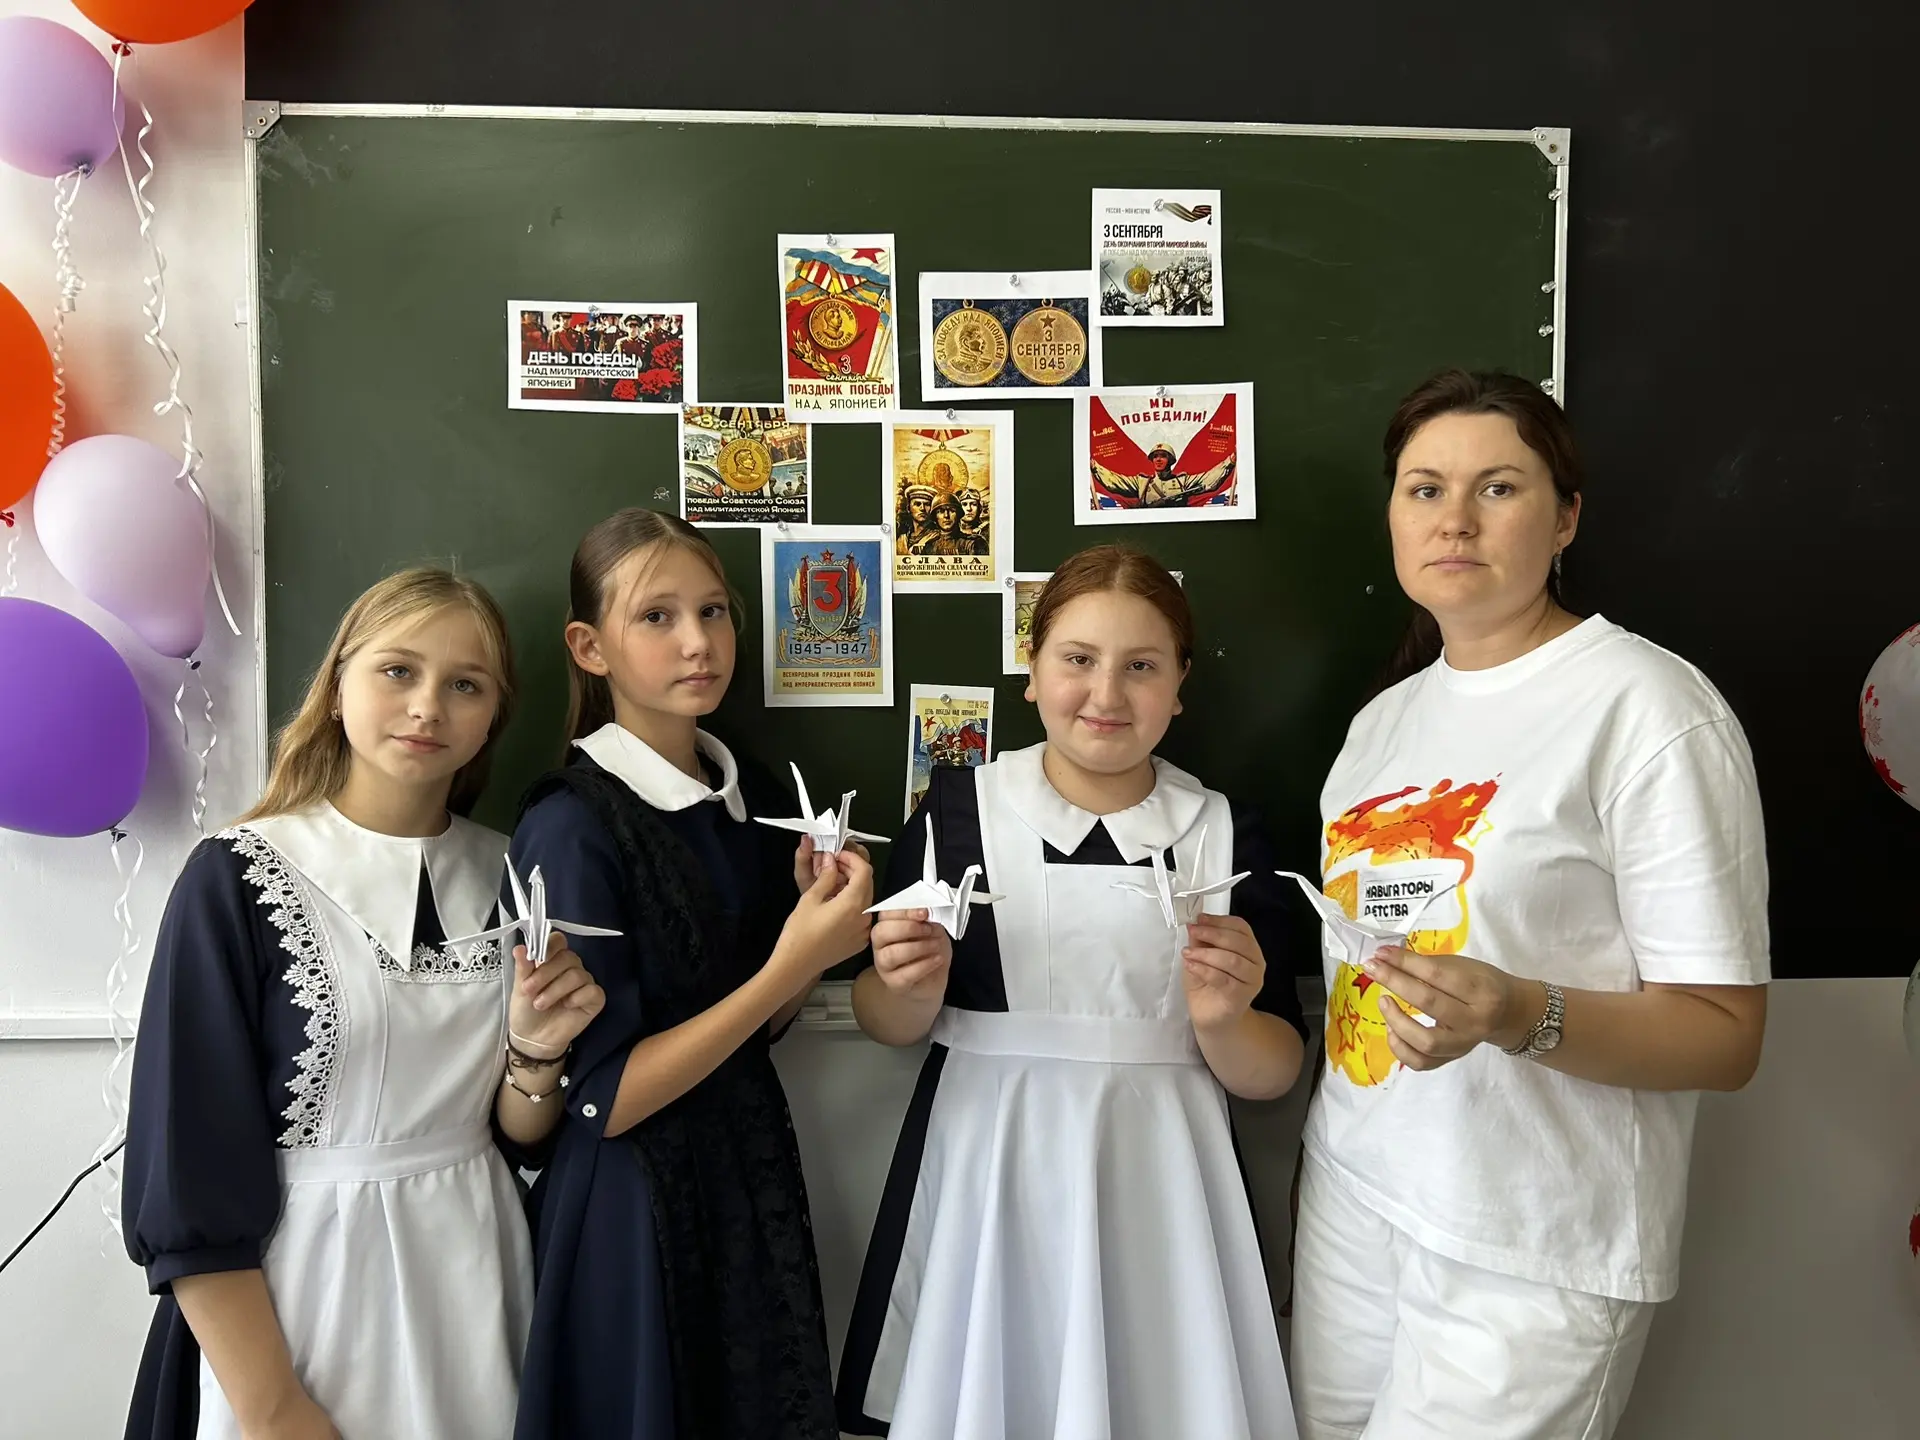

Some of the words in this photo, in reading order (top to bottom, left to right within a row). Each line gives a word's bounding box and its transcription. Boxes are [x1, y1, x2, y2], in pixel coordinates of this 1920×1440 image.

[1103, 224, 1110, 238] 3
[1112, 224, 1163, 238] СЕНТЯБРЯ
[1147, 240, 1165, 248] ВТОРОЙ
[1166, 240, 1189, 248] МИРОВОЙ
[963, 312, 981, 323] НАД
[937, 315, 961, 347] ПОБЕДУ
[1043, 329, 1053, 342] 3
[984, 318, 1005, 360] ЯПОНИЕЙ
[937, 346, 947, 361] ЗА
[1016, 344, 1081, 357] СЕНТЯБРЯ
[527, 351, 569, 366] ДЕНЬ
[571, 352, 637, 368] ПОБЕДЫ
[840, 354, 852, 374] 3
[1033, 357, 1066, 370] 1945
[527, 367, 548, 376] НАД
[549, 368, 635, 378] МИЛИТАРИСТСКОЙ
[527, 378, 572, 388] ЯПОНИЕЙ
[788, 383, 842, 396] ПРАЗДНИК
[850, 383, 894, 396] ПОБЕДЫ
[795, 398, 822, 410] НАД
[829, 396, 887, 410] ЯПОНИЕЙ
[1149, 398, 1174, 409] МЫ
[720, 419, 790, 430] СЕНТЯБРЯ
[1120, 410, 1207, 426] ПОБЕДИЛИ!
[901, 556, 982, 564] СЛАВА
[812, 571, 842, 613] 3
[1017, 616, 1031, 635] 3
